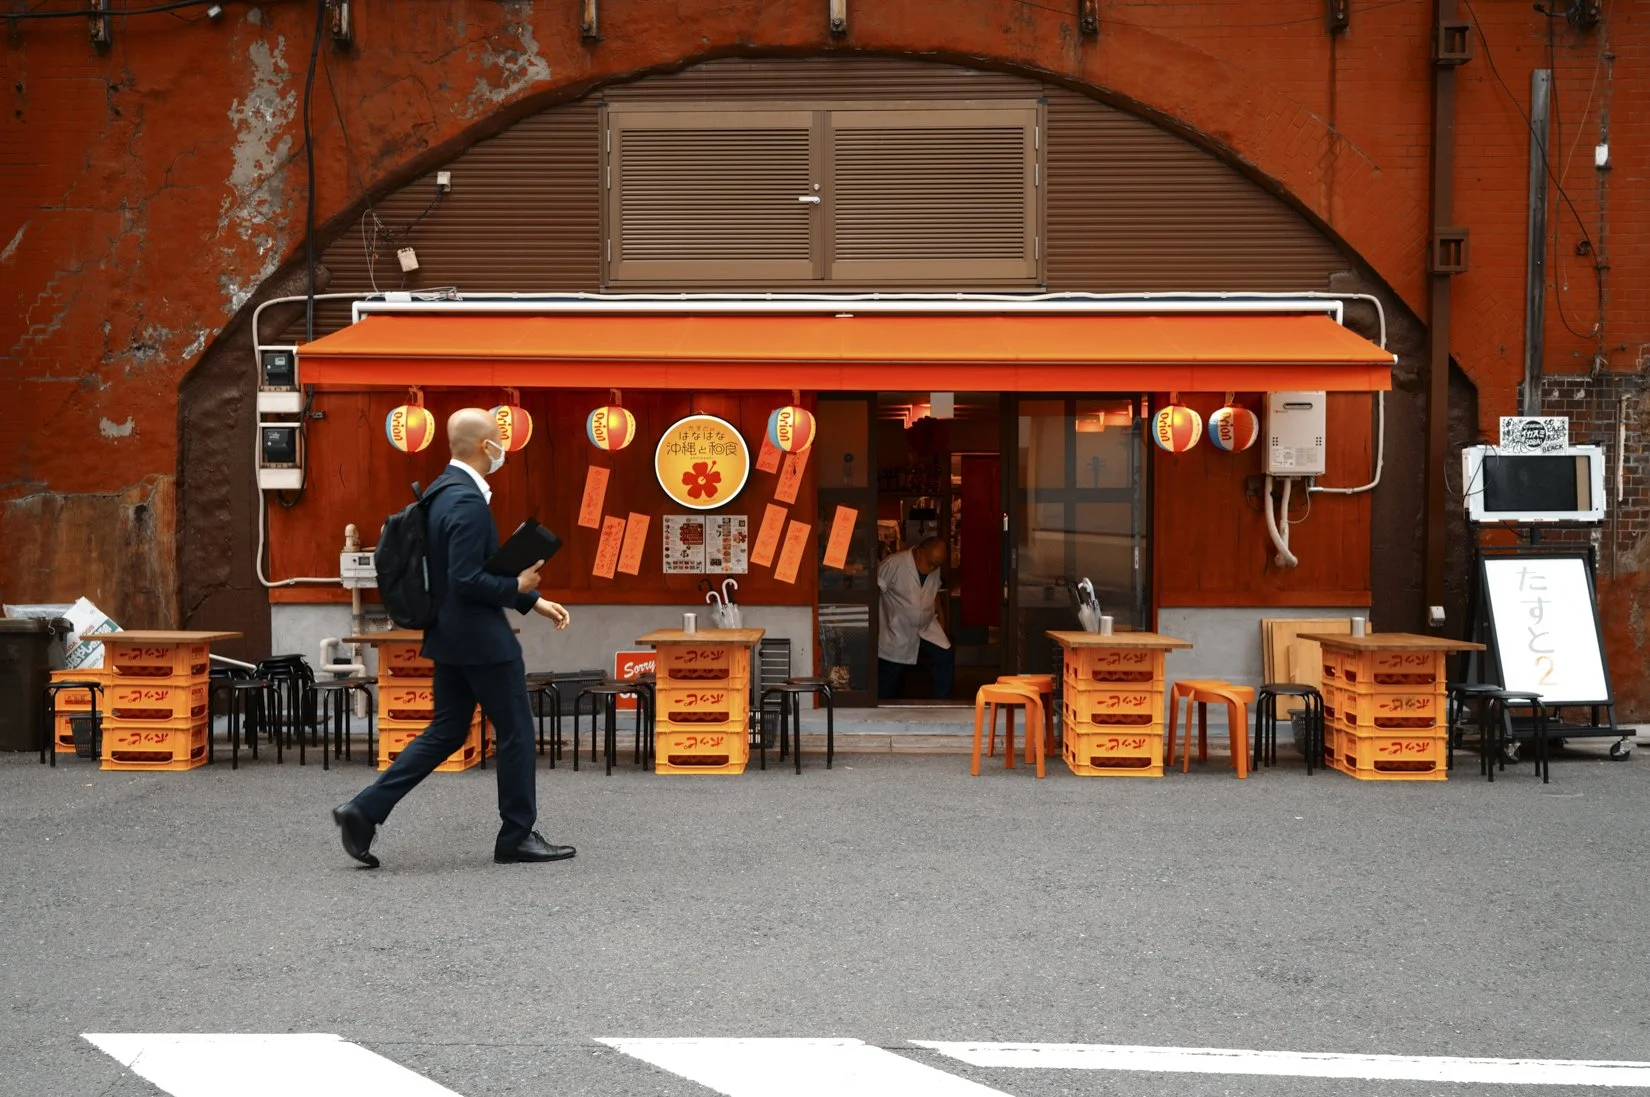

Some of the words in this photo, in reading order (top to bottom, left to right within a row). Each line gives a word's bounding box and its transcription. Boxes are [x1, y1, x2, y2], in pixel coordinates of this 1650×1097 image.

[394, 411, 405, 442] Orion
[594, 412, 606, 442] Orion
[779, 412, 792, 441] Orion
[1159, 412, 1171, 442] Orion
[1219, 412, 1233, 441] Orion
[679, 431, 726, 441] はなはな
[666, 441, 738, 456] 沖縄と和食
[1542, 444, 1564, 453] BLACK
[119, 648, 168, 660] ホッピー
[394, 649, 416, 662] ピー
[674, 650, 724, 663] ホッピー
[1098, 652, 1147, 665] ホッピー
[1379, 654, 1429, 668] ホッピー
[623, 660, 656, 679] Sorry
[119, 690, 168, 703] ホッピー
[674, 693, 724, 707] ホッピー
[1097, 695, 1146, 708] ホッピー
[118, 733, 168, 745] ホッピー
[674, 736, 724, 750] ホッピー
[1096, 738, 1146, 751] ホッピー
[1379, 742, 1430, 755] ホッピー
